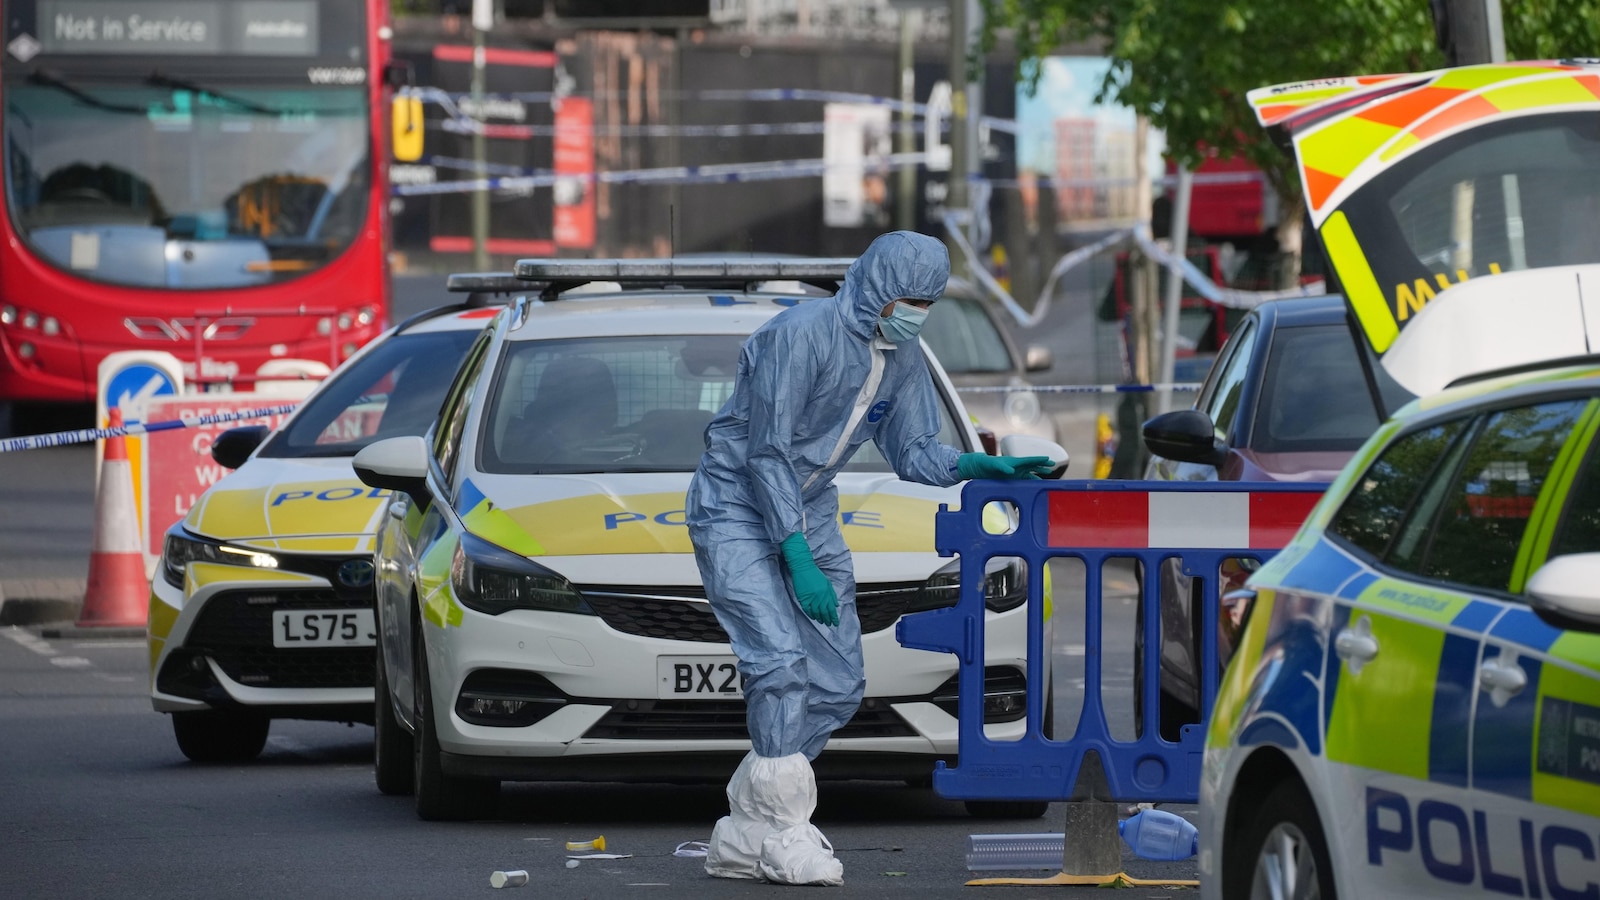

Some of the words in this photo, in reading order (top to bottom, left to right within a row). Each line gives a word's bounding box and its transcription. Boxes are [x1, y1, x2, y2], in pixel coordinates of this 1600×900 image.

[55, 13, 97, 41] Not
[102, 15, 124, 41] in
[128, 13, 207, 41] Service
[2, 437, 31, 452] LINE
[35, 435, 53, 448] DO
[56, 430, 82, 446] NOT
[86, 425, 129, 441] CROSS
[271, 487, 391, 506] POL
[604, 510, 885, 530] POE
[284, 614, 357, 641] LS75
[674, 663, 746, 693] BX2
[1366, 786, 1600, 900] POLIC
